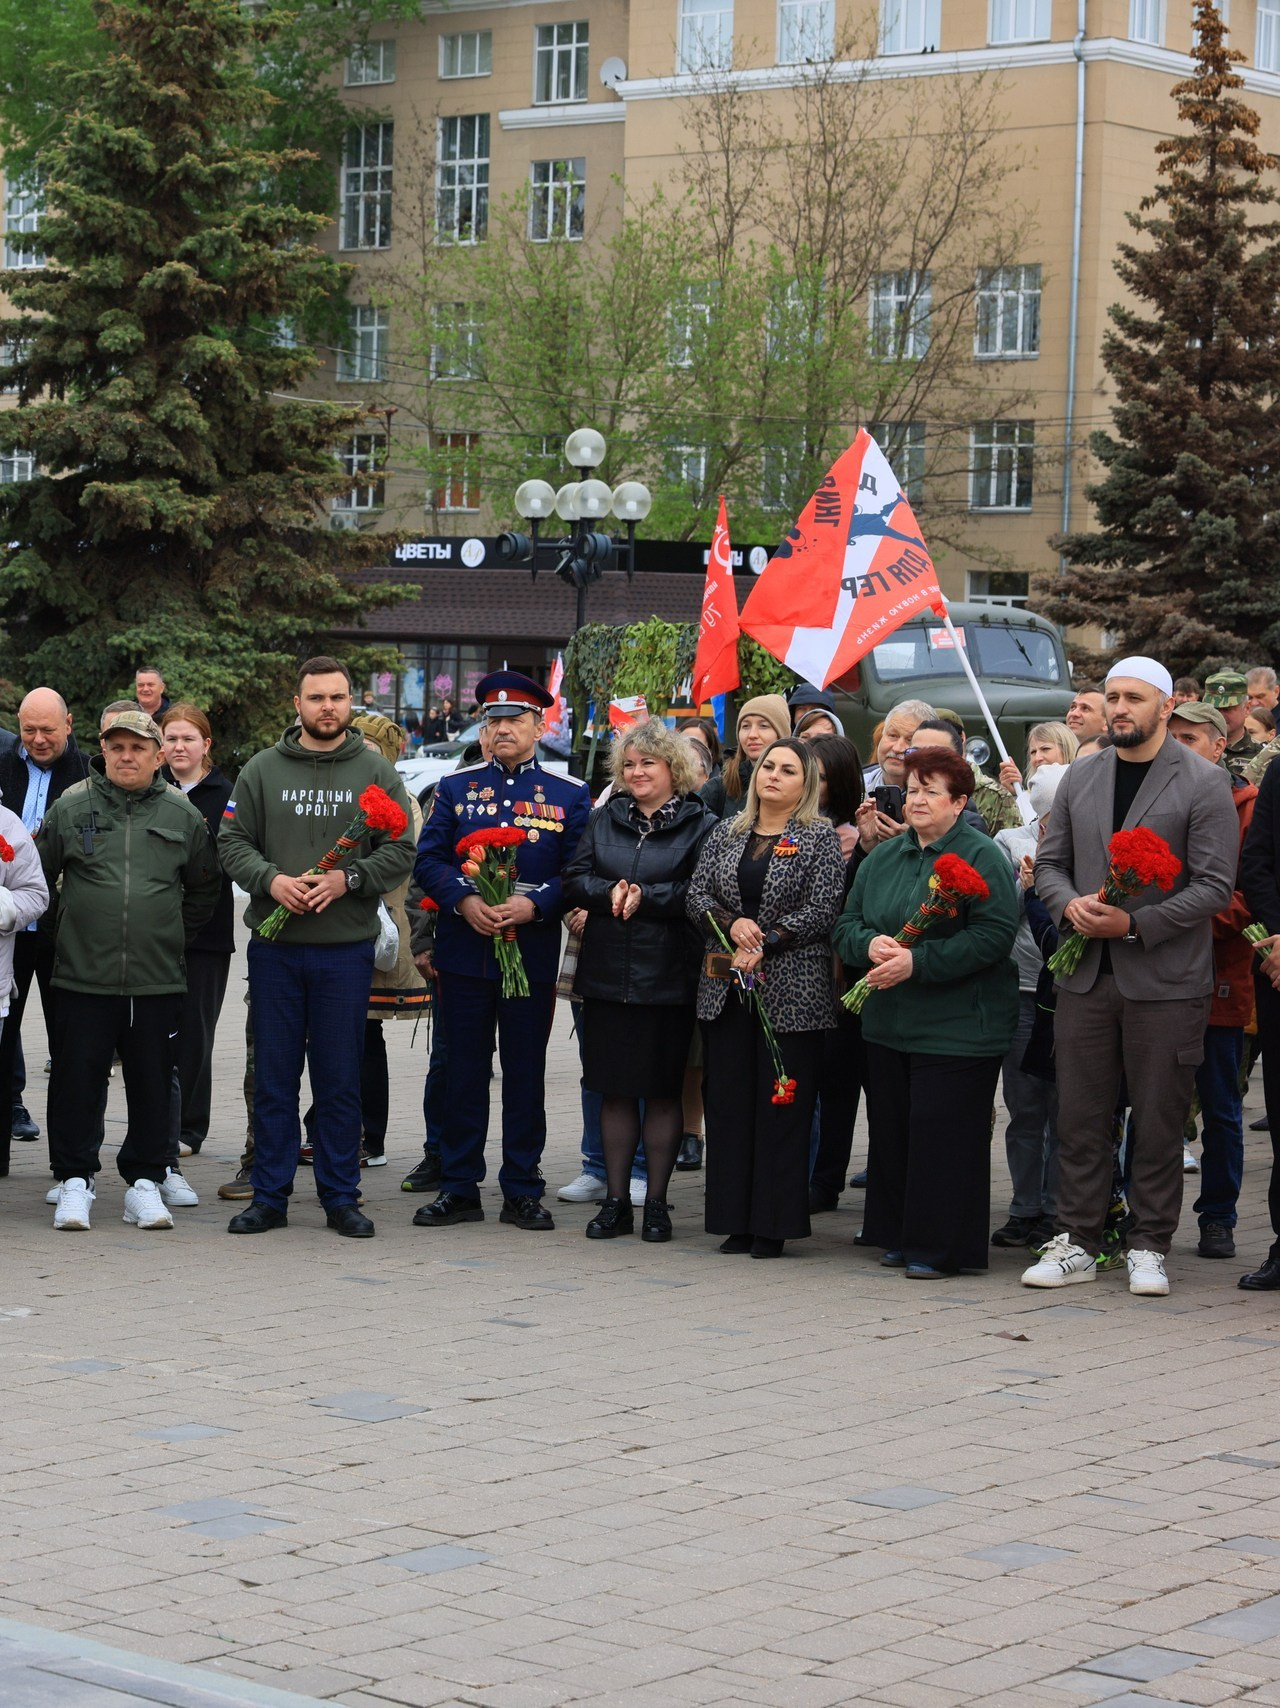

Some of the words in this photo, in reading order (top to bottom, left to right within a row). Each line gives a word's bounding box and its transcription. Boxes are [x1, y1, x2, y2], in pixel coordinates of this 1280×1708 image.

[395, 543, 452, 561] ЦВЕТЫ
[282, 788, 353, 803] НАРОДНЫЙ
[295, 803, 338, 816] ФРОНТ
